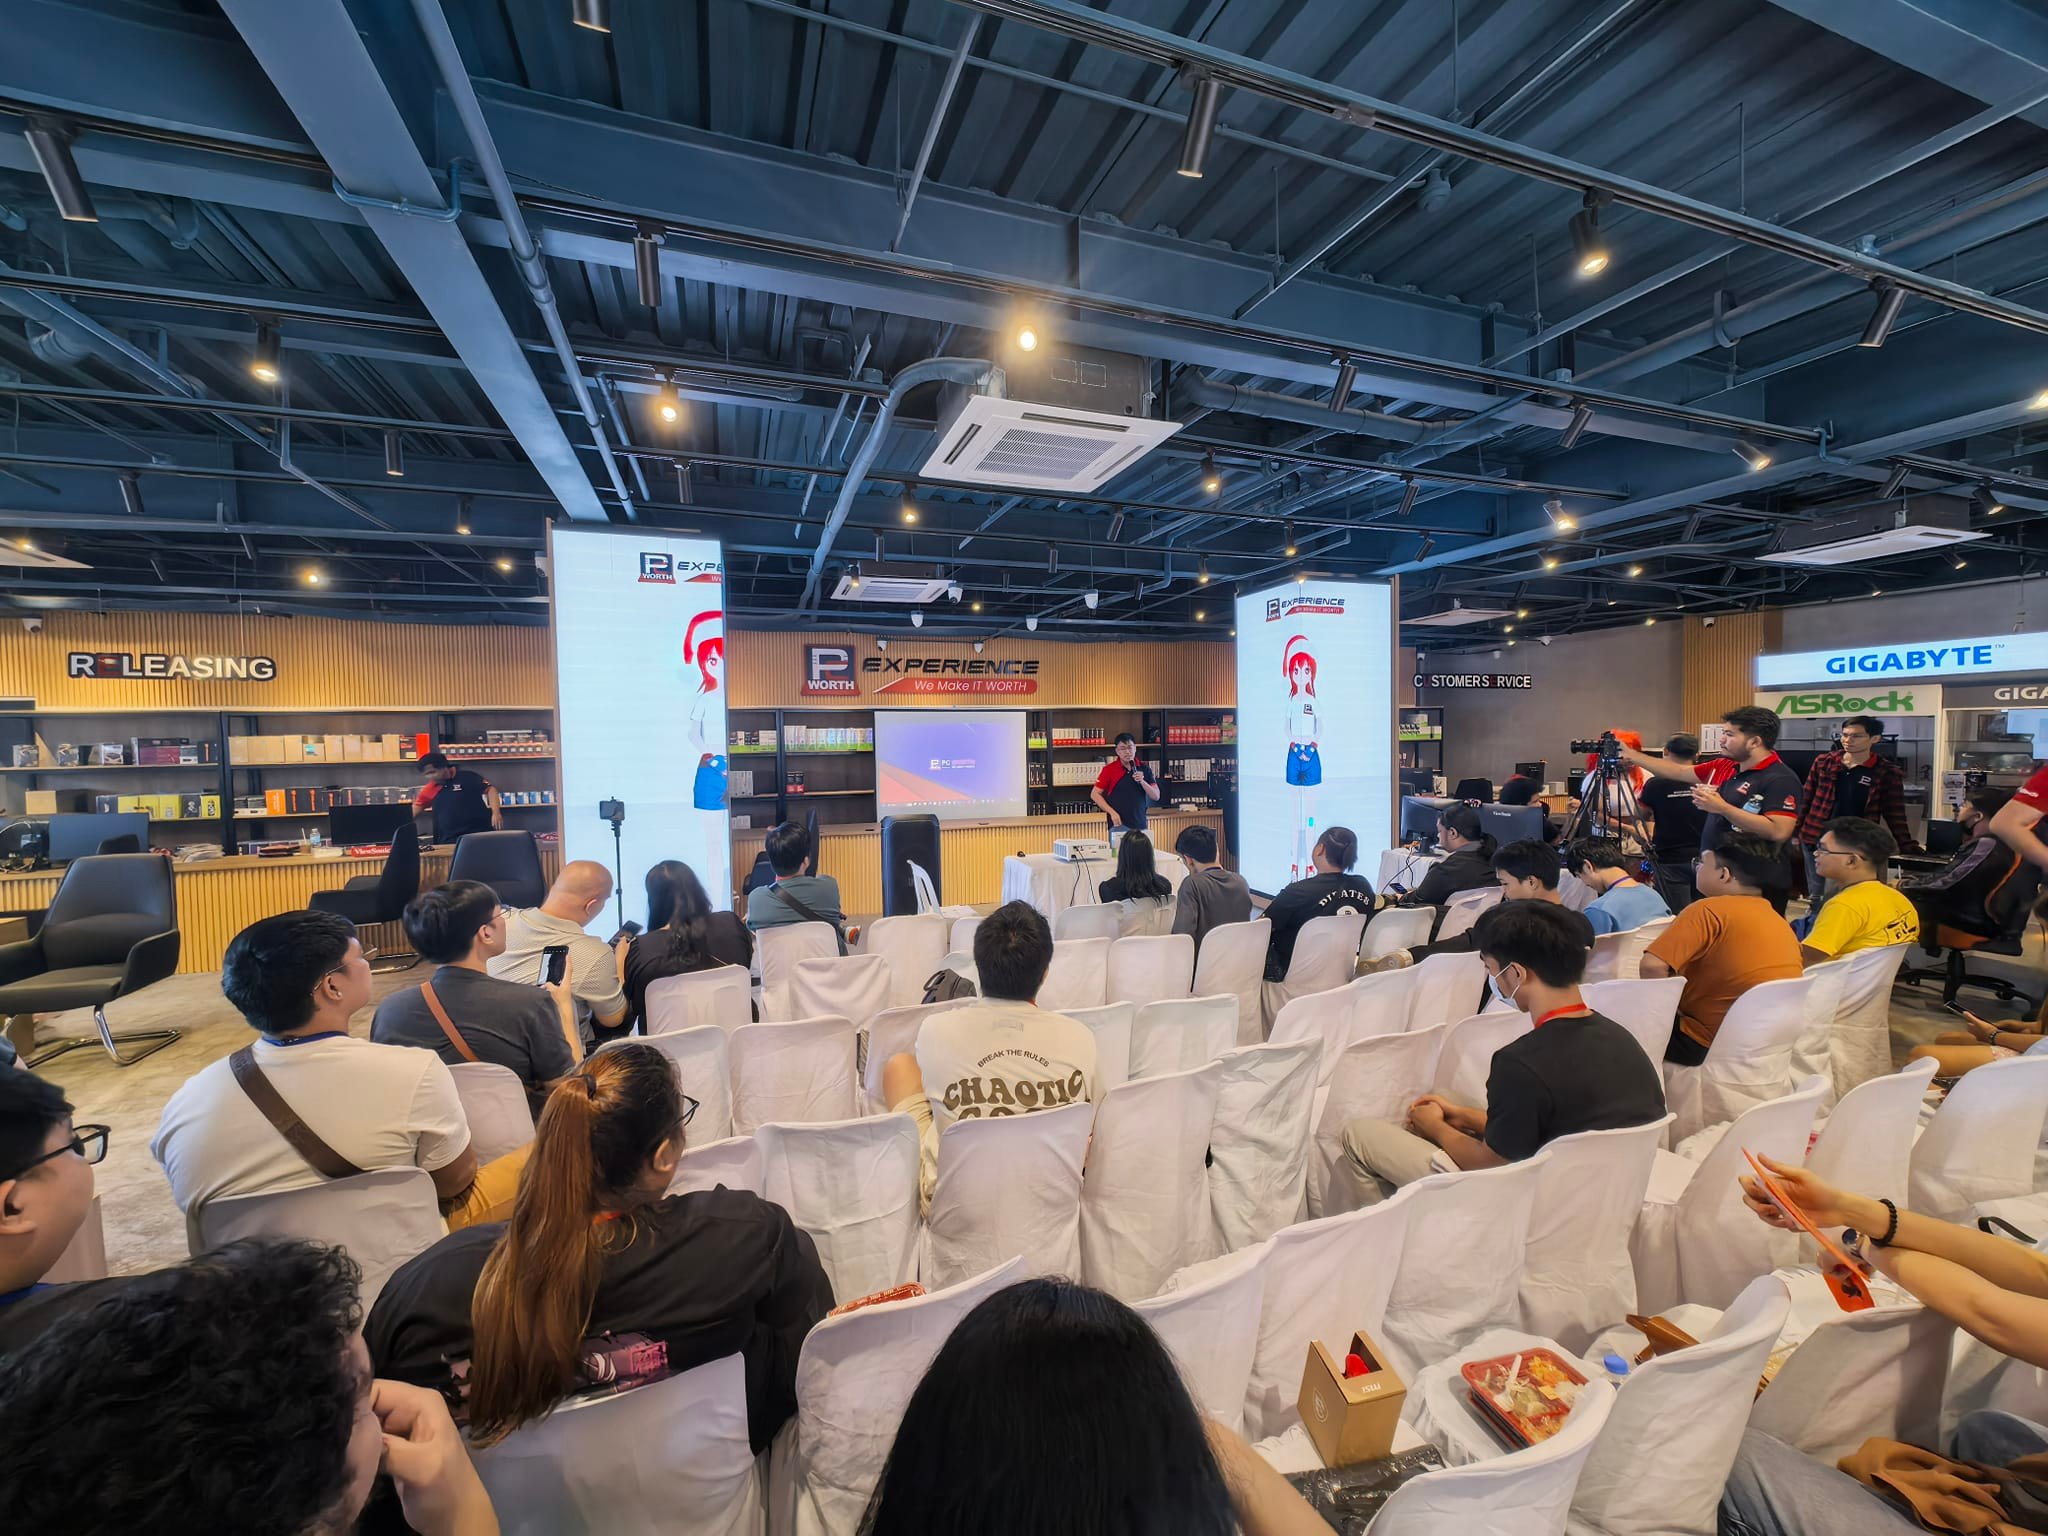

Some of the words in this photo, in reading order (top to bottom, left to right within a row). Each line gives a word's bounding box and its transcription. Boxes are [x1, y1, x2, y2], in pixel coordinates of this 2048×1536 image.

[1281, 597, 1345, 608] EXPERIENCE
[862, 657, 1040, 674] EXPERIENCE
[1826, 645, 1992, 674] GIGABYTE
[807, 680, 855, 690] WORTH
[914, 680, 934, 691] We
[937, 680, 969, 691] Make
[972, 681, 983, 690] IT
[986, 681, 1027, 691] WORTH
[1775, 690, 1915, 714] ASRock
[977, 1050, 1005, 1067] BREAK
[1006, 1049, 1022, 1057] THE
[1023, 1050, 1049, 1067] RULES
[942, 1069, 1083, 1111] CHAOTIC
